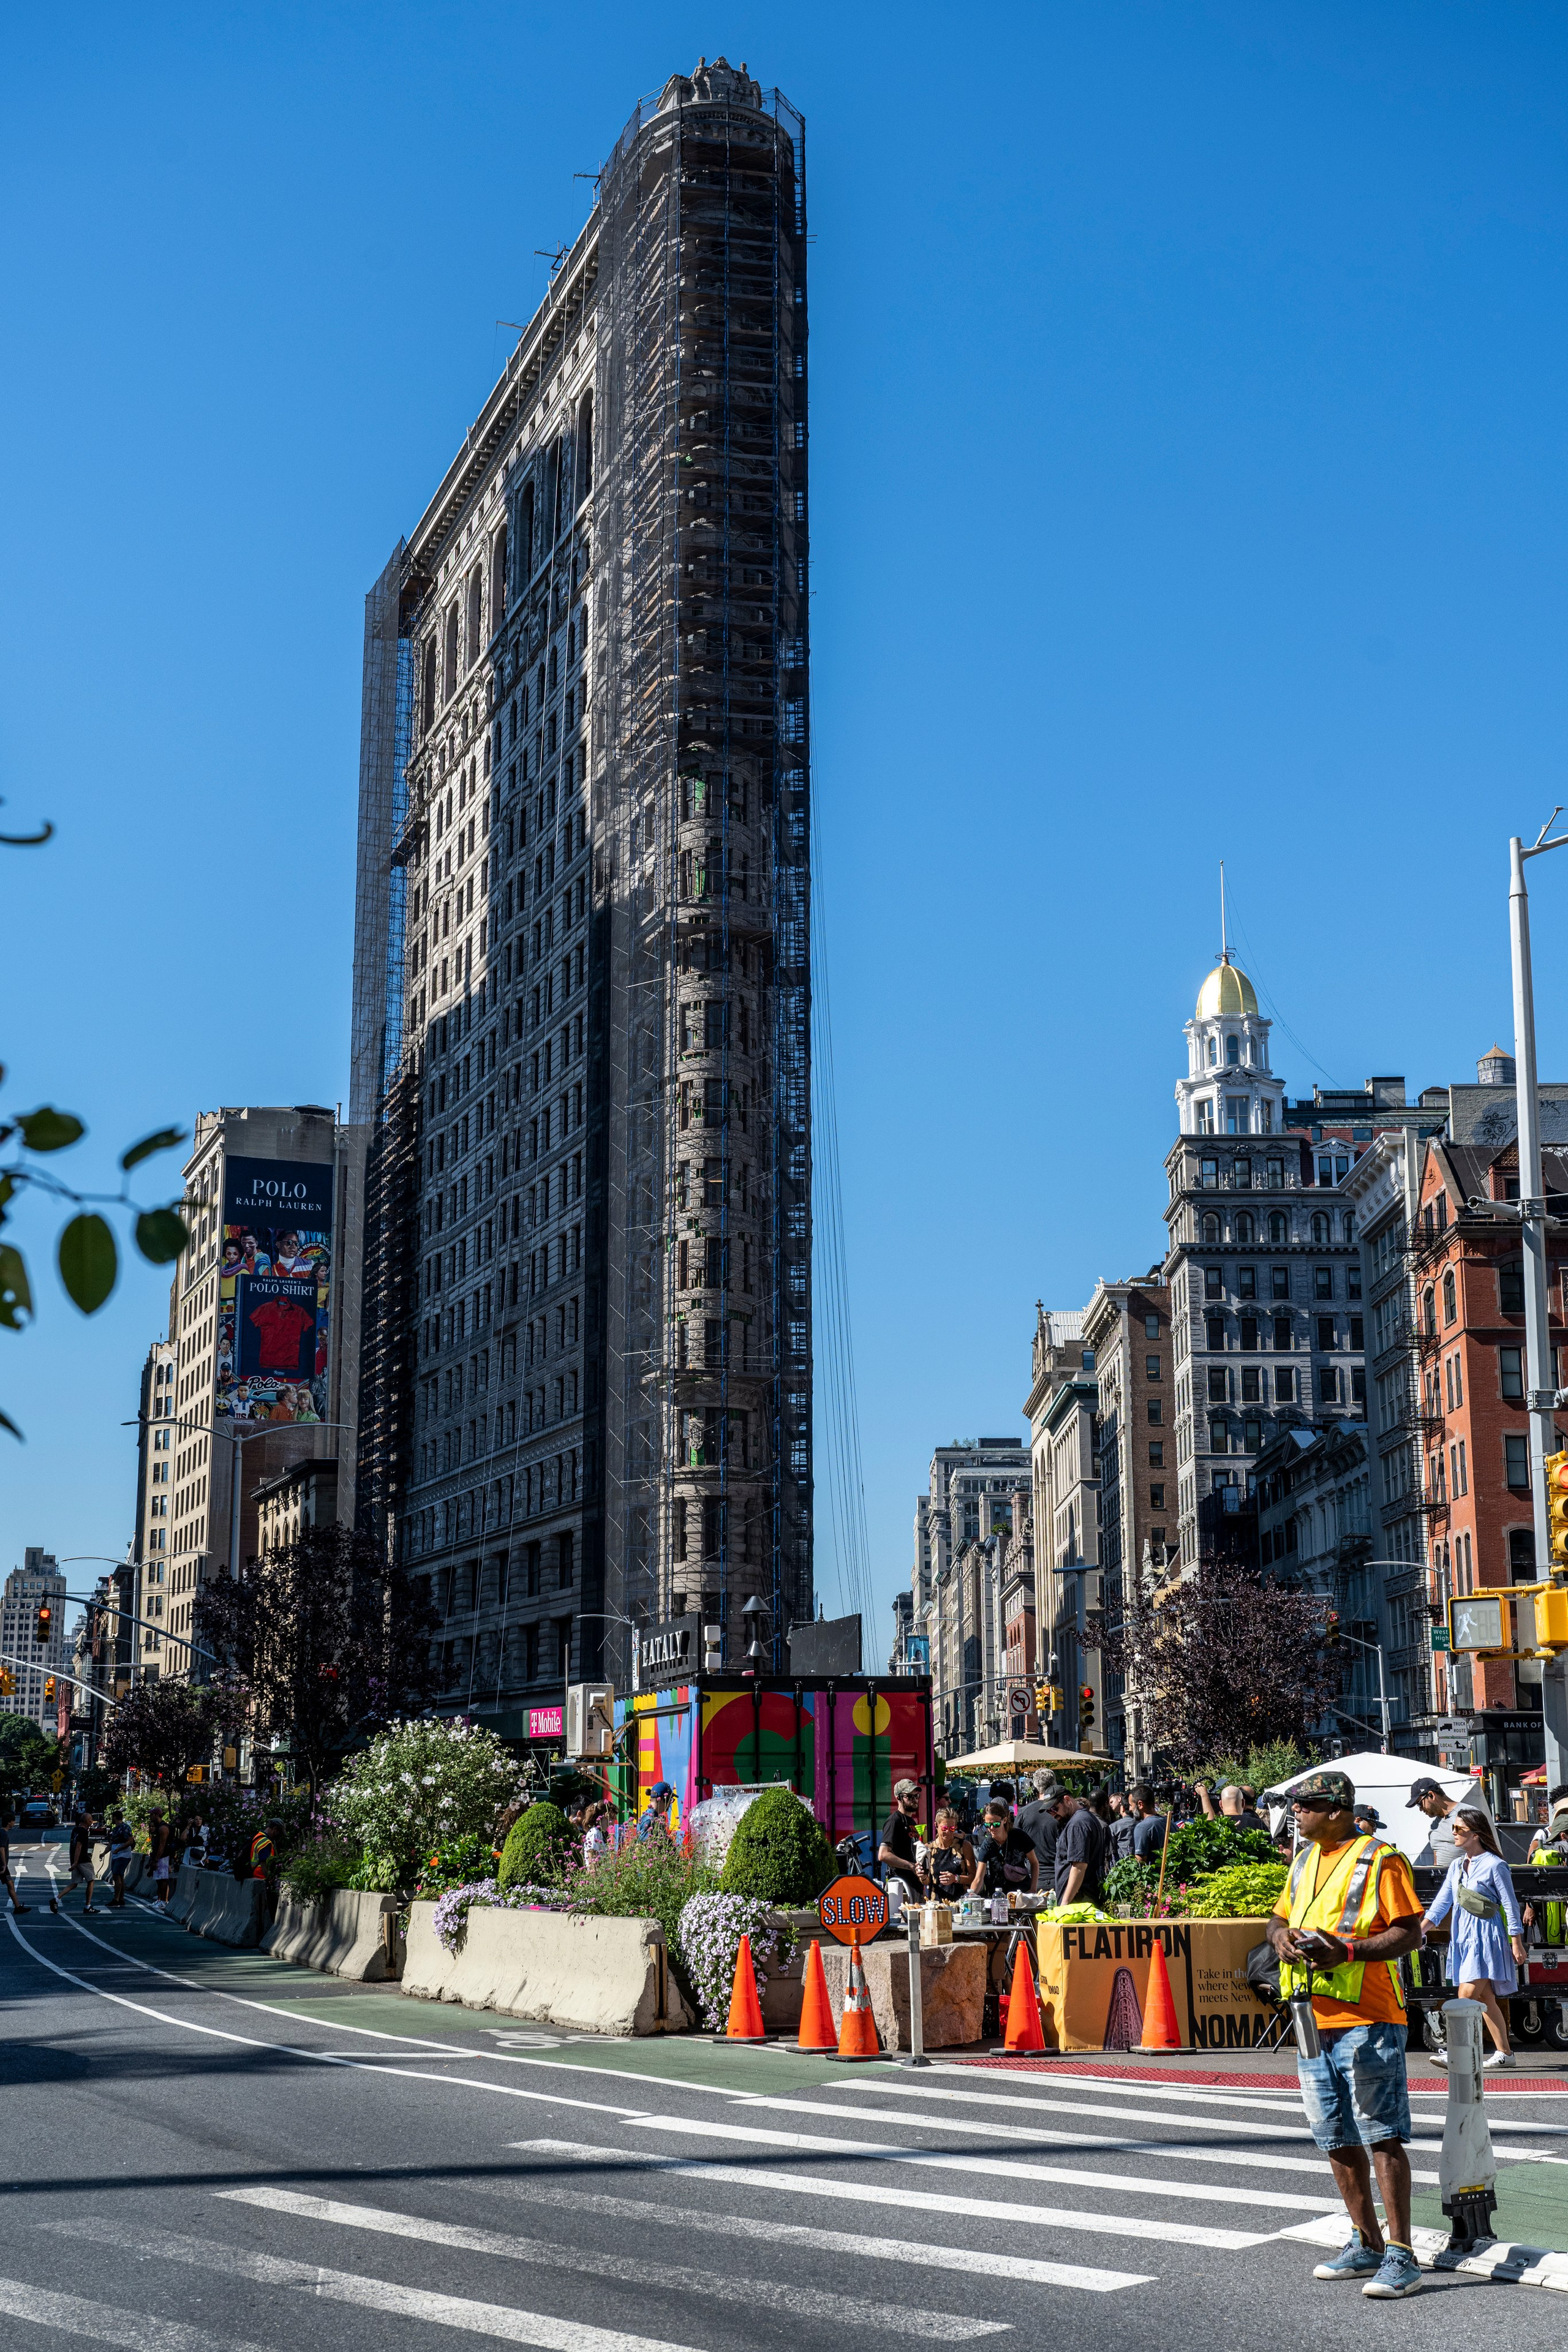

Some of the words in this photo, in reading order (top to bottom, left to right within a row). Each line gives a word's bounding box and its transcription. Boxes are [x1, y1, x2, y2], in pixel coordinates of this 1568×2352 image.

[253, 1179, 306, 1199] POLO
[236, 1197, 272, 1207] RALPH
[279, 1201, 322, 1211] LAUREN
[249, 1282, 279, 1294] POLO
[282, 1284, 314, 1296] SHIRT
[248, 1376, 281, 1390] Polo
[643, 1630, 684, 1667] EATALY
[823, 1896, 885, 1925] SLOW
[1063, 1924, 1191, 1959] FLATIRON
[1197, 1969, 1220, 1979] Take
[1223, 1968, 1232, 1979] in
[1197, 1981, 1228, 1991] where
[1231, 1981, 1251, 1991] New
[1199, 1994, 1228, 2003] meets
[1231, 1992, 1252, 2002] New
[1188, 2014, 1287, 2048] NOMAD
